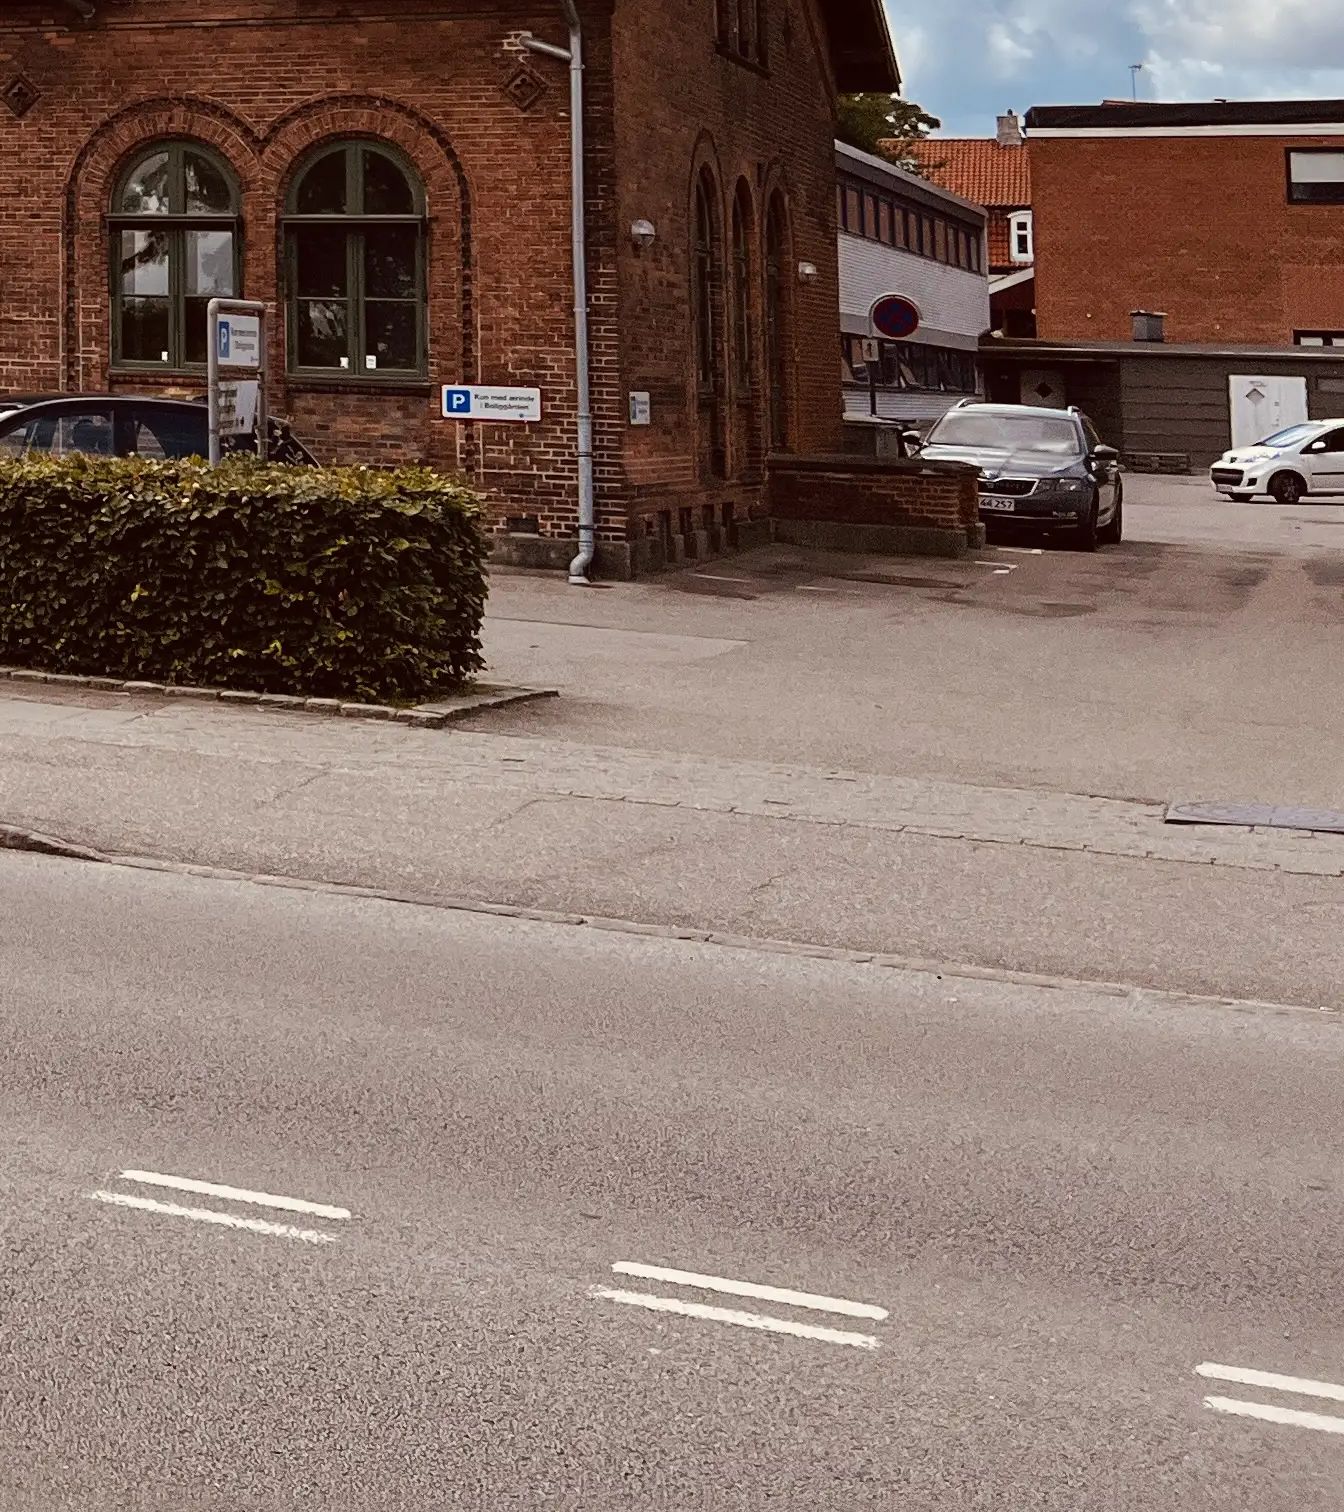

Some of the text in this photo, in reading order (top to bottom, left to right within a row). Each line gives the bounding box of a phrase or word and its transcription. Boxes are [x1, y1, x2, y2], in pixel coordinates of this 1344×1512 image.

[220, 327, 228, 351] P
[452, 393, 466, 409] P
[994, 499, 1013, 509] 257
